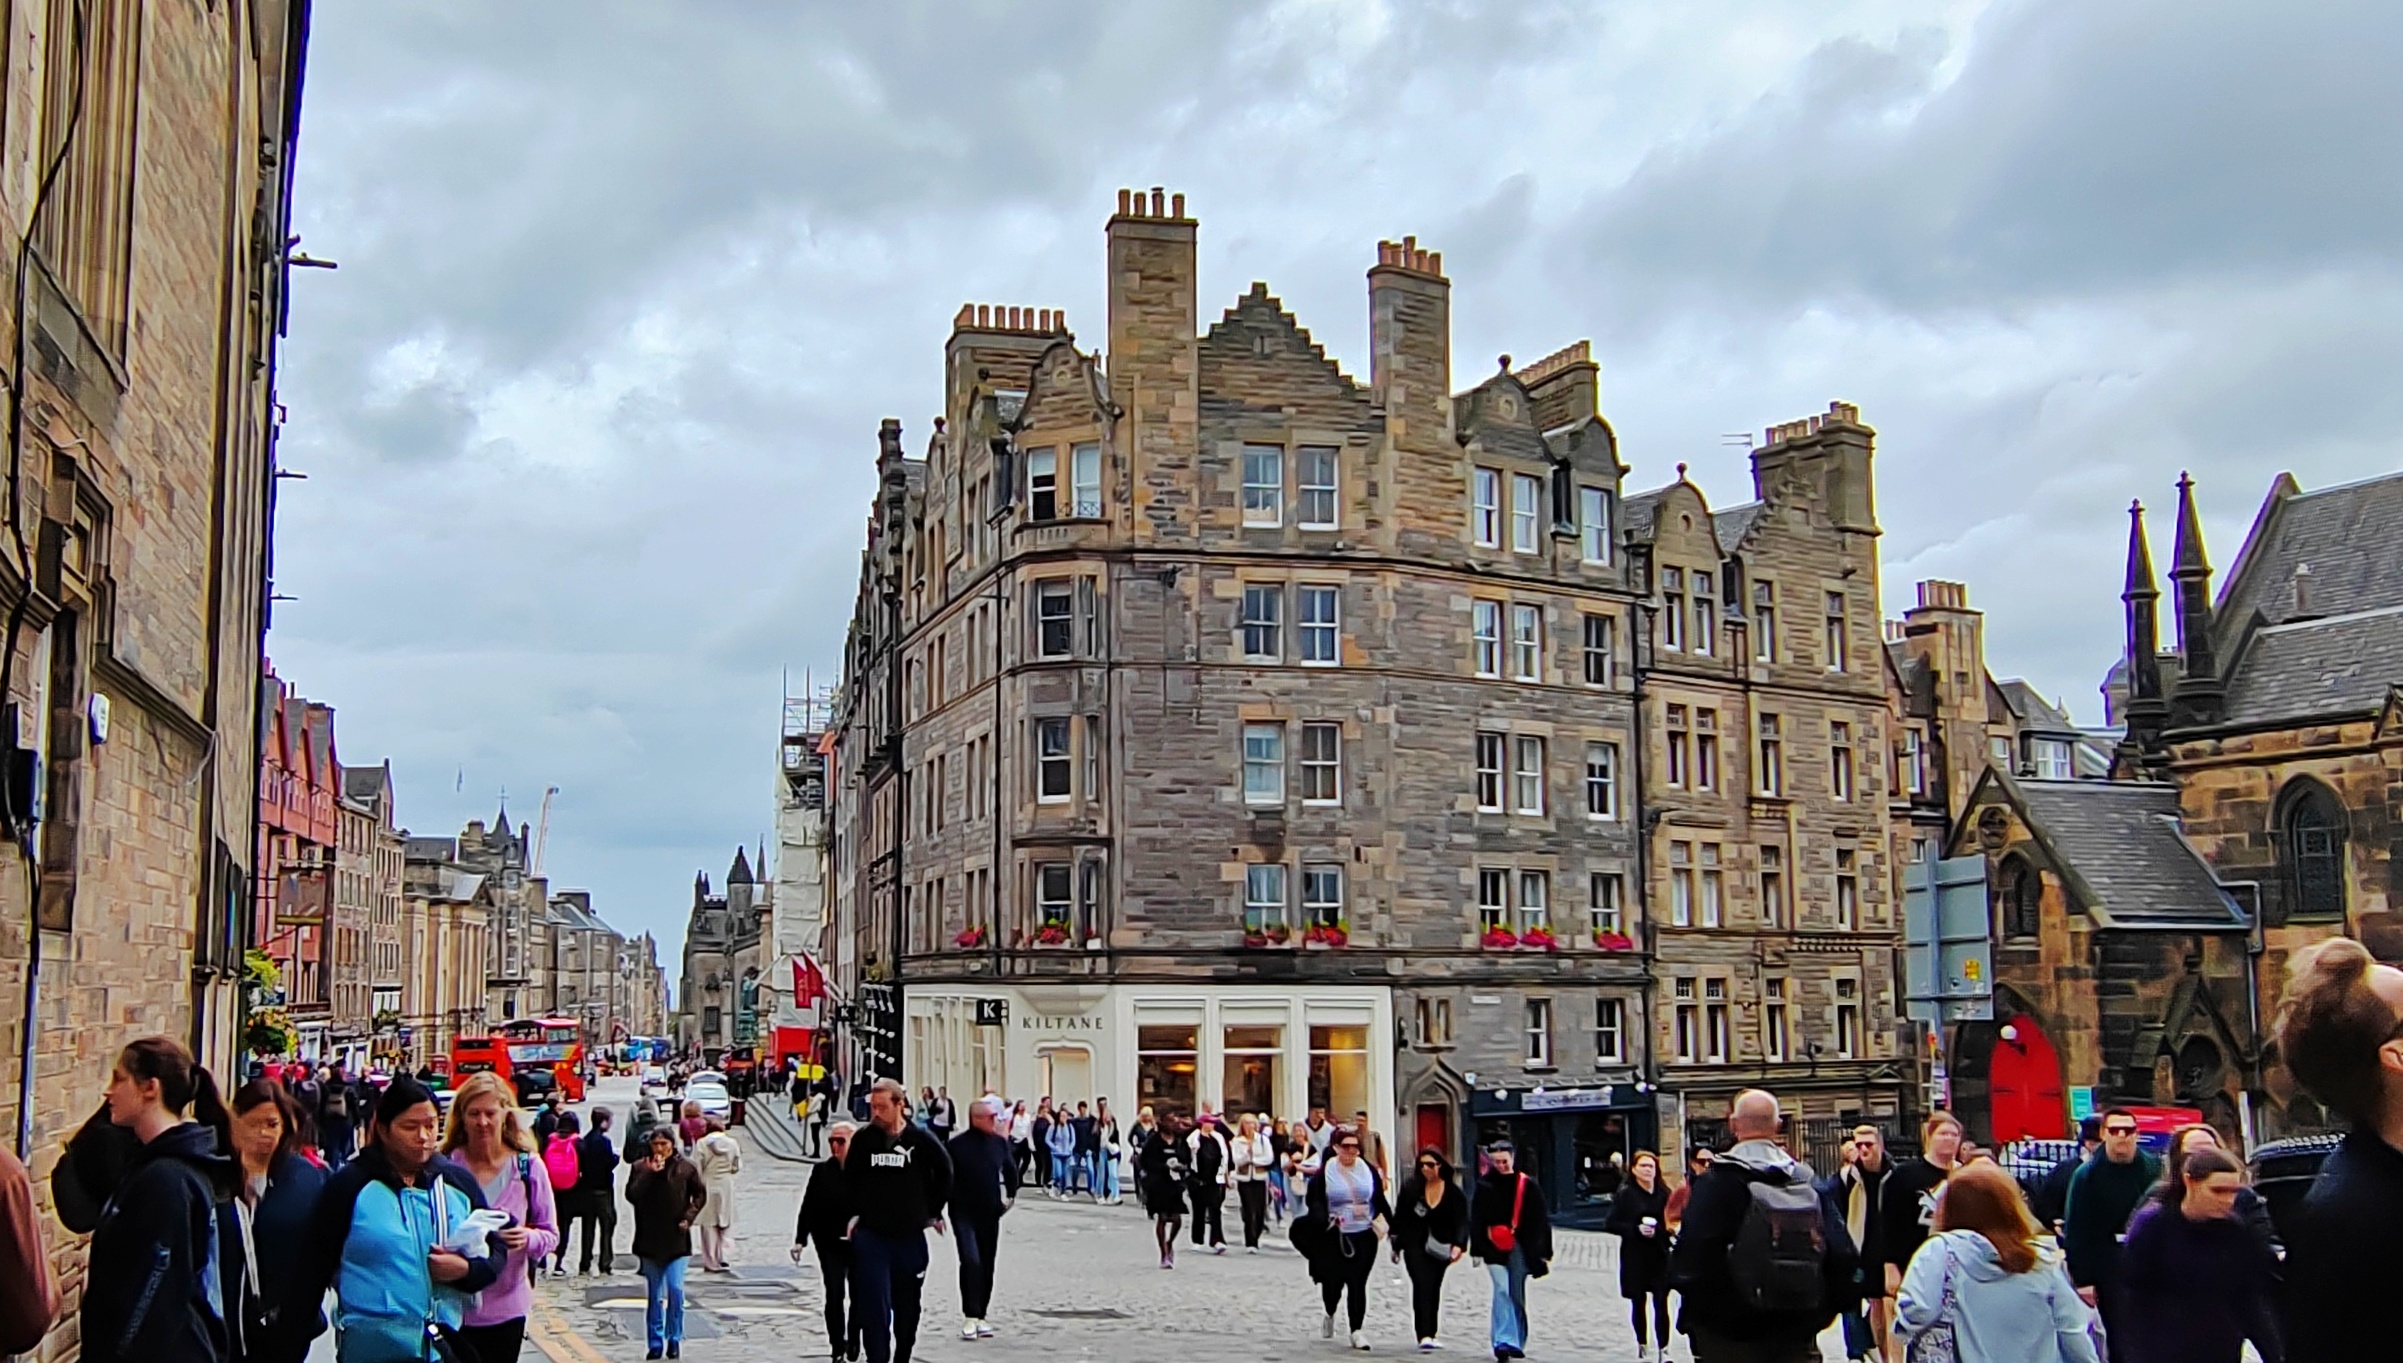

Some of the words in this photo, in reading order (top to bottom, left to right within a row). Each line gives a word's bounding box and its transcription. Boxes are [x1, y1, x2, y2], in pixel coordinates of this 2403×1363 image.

[841, 1007, 850, 1018] K
[983, 1002, 996, 1018] K
[1022, 1016, 1103, 1030] KILTANE
